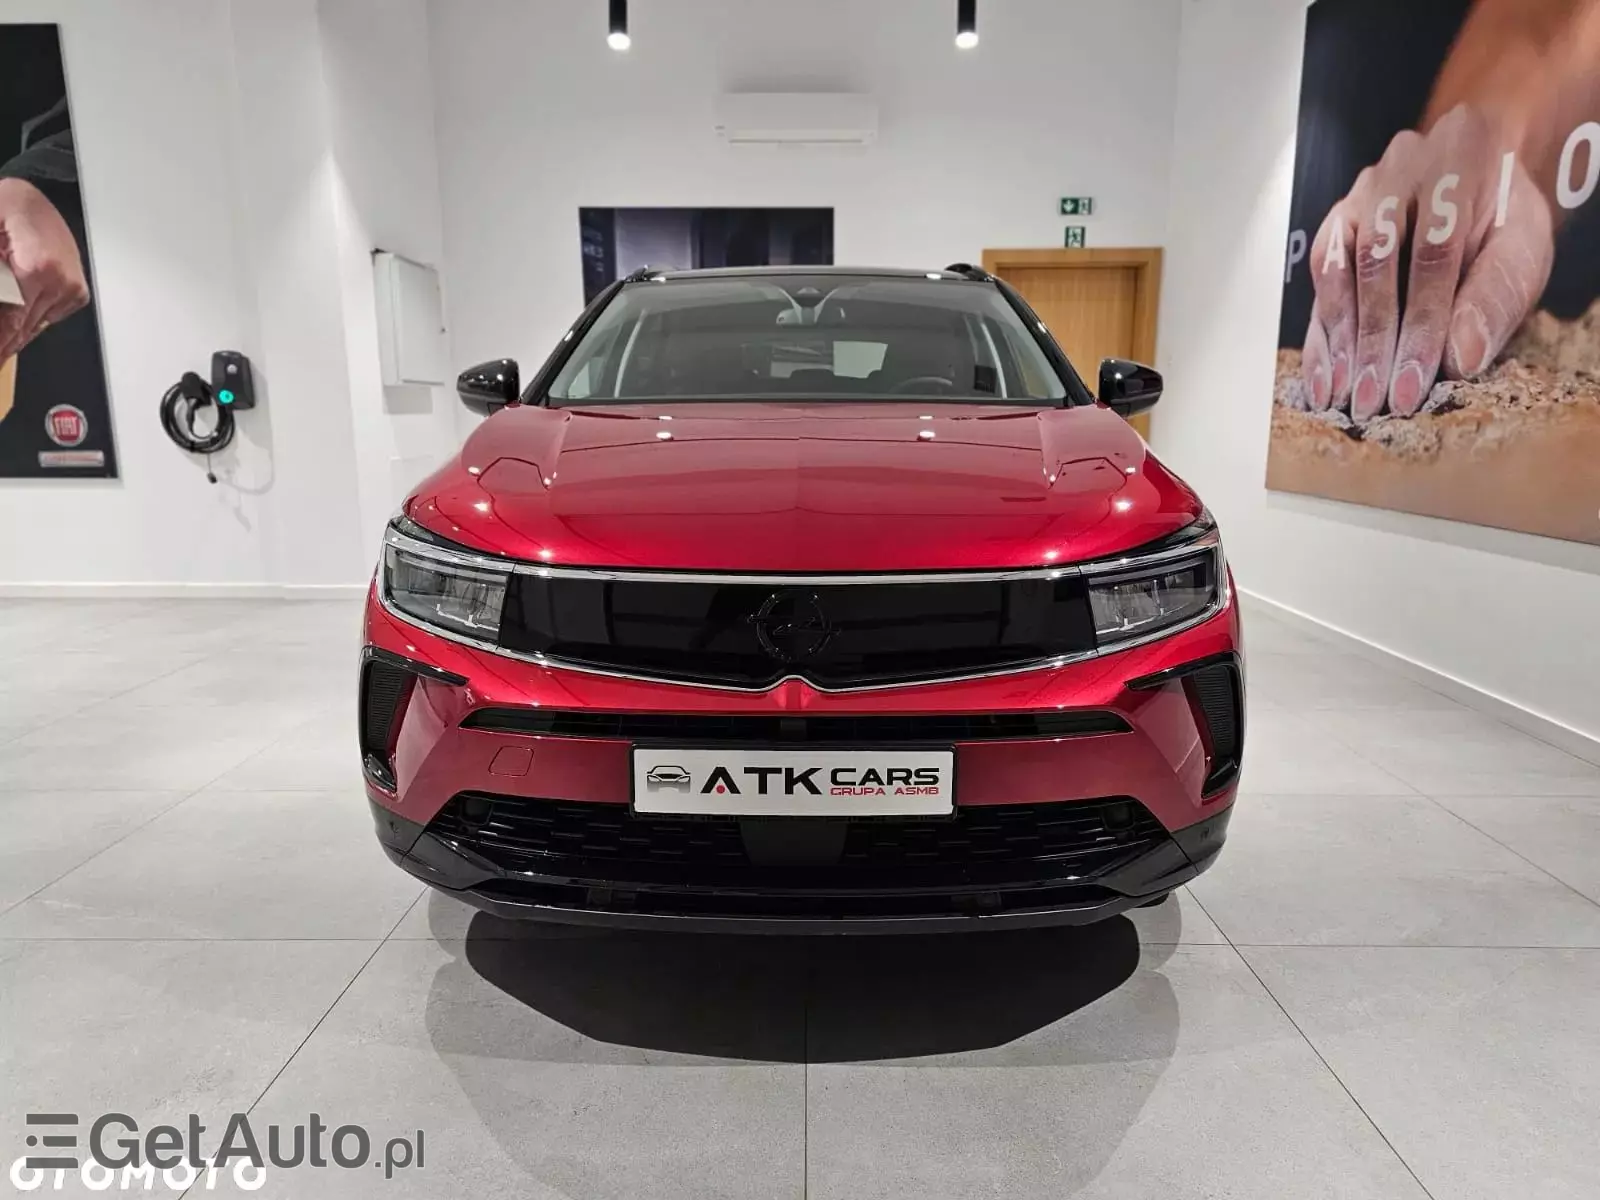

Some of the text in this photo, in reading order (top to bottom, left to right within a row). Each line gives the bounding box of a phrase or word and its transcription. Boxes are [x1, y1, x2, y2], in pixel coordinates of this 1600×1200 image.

[700, 766, 940, 795] ATK CARS
[830, 786, 940, 796] GRUPA ASMB
